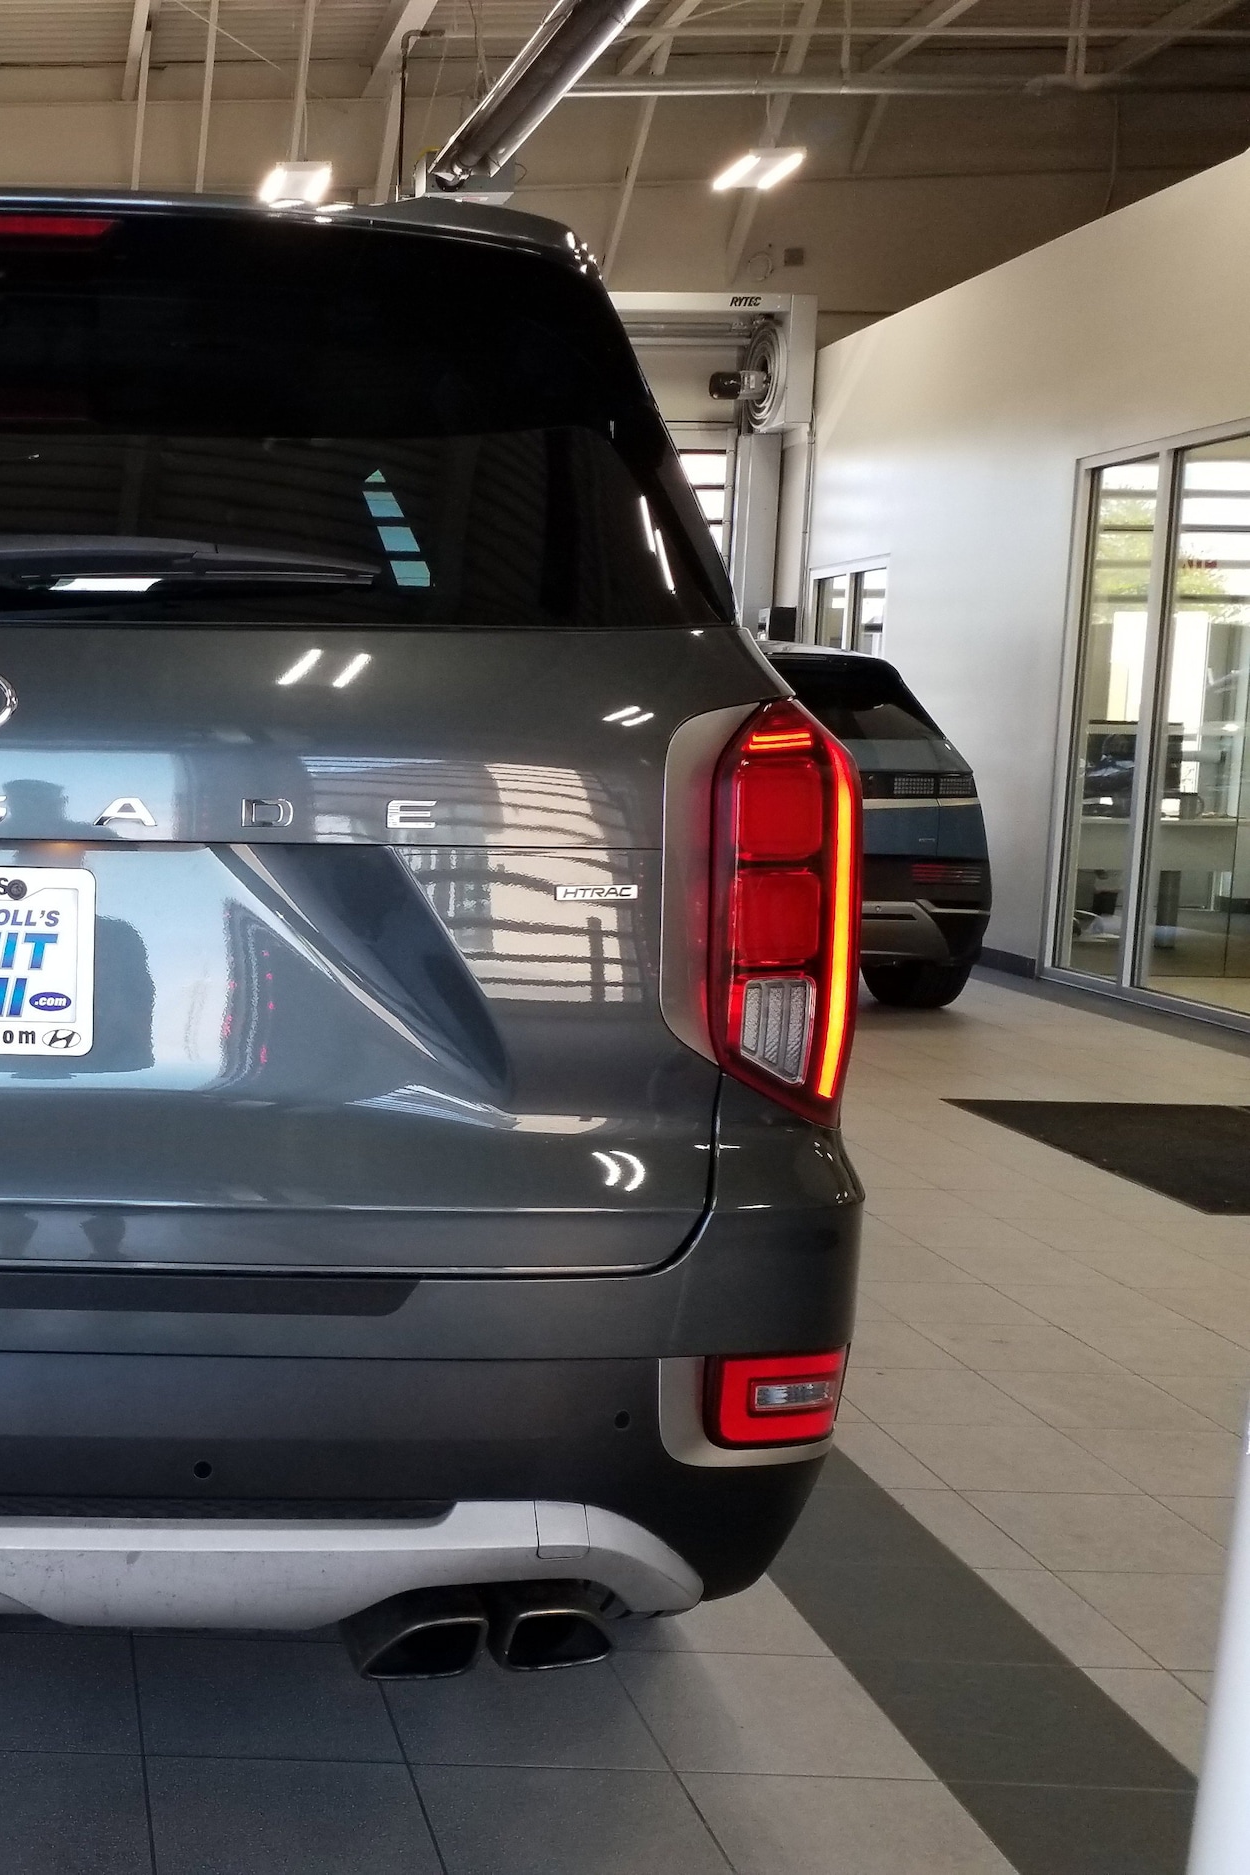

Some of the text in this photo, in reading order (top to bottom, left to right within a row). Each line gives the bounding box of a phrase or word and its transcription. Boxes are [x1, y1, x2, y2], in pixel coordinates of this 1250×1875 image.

[729, 296, 762, 307] RYTEC
[563, 887, 632, 898] HTRAC
[33, 995, 67, 1008] .com
